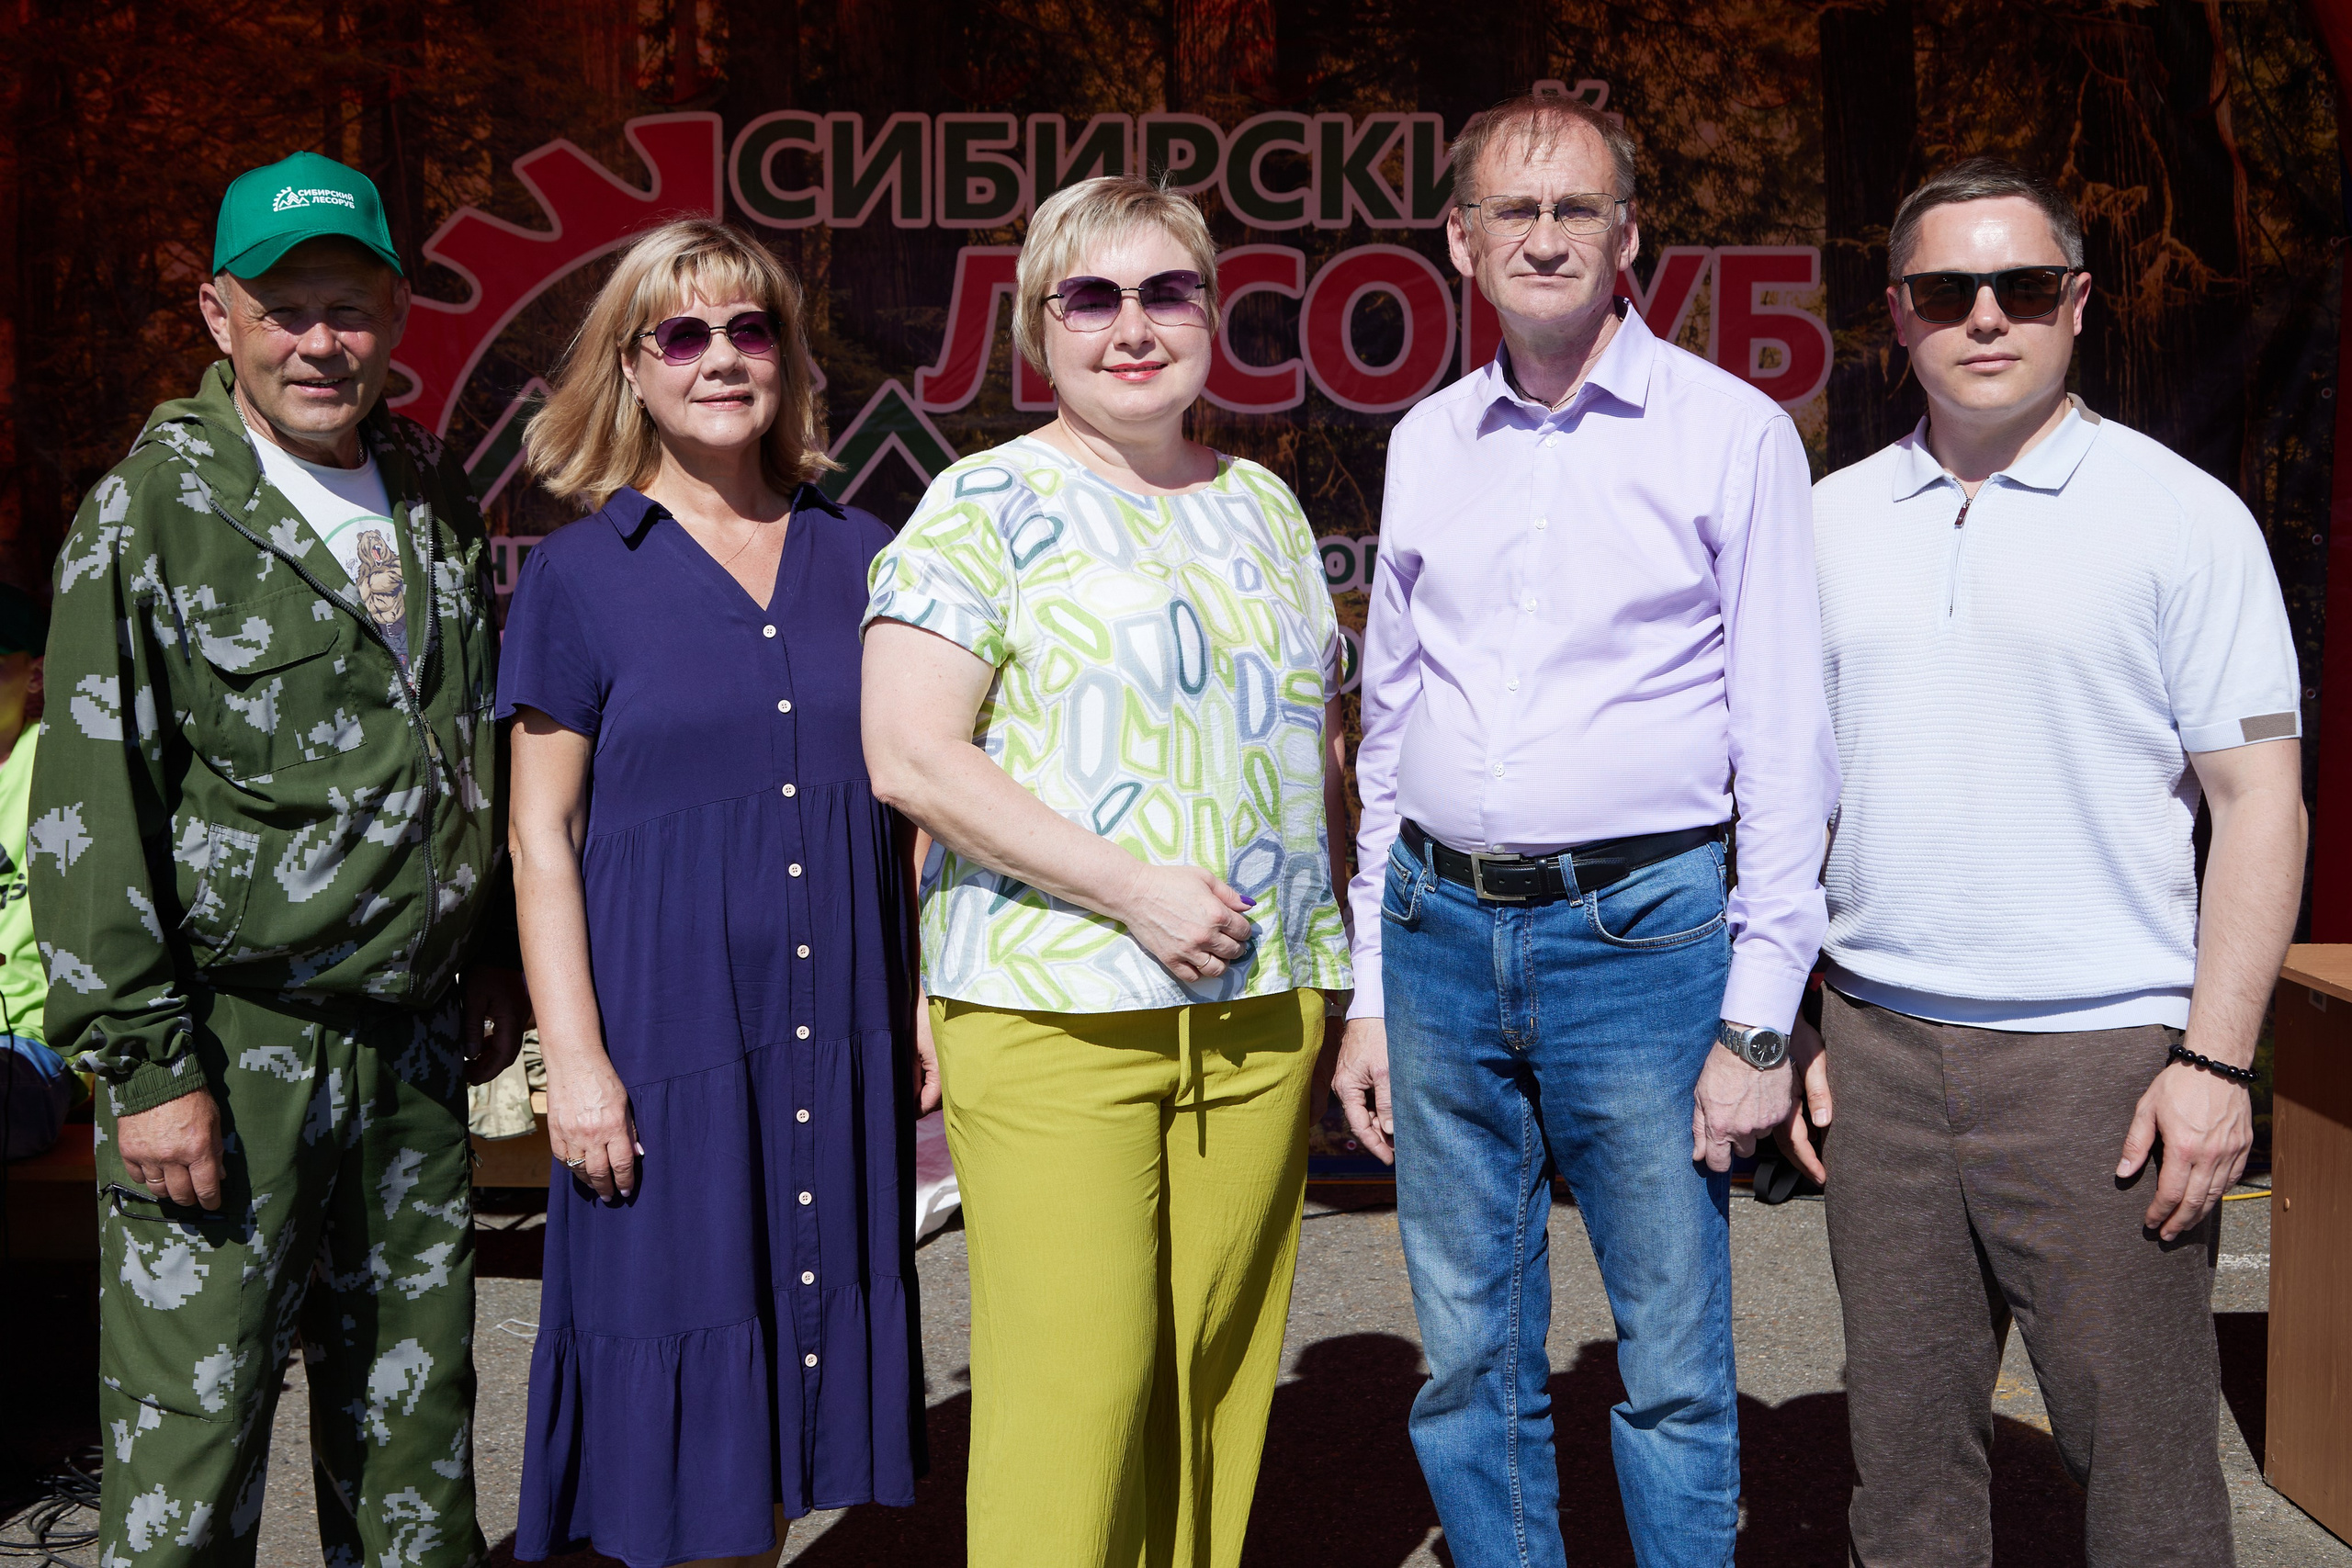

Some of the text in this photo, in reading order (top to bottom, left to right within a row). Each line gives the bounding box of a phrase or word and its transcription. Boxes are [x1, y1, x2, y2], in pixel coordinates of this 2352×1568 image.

[298, 188, 354, 201] СИБИРСКИЙ
[730, 80, 1624, 229] СИБИРСКИ
[311, 196, 356, 209] ЛЕСОРУБ
[914, 244, 1835, 413] ЛСОУБ
